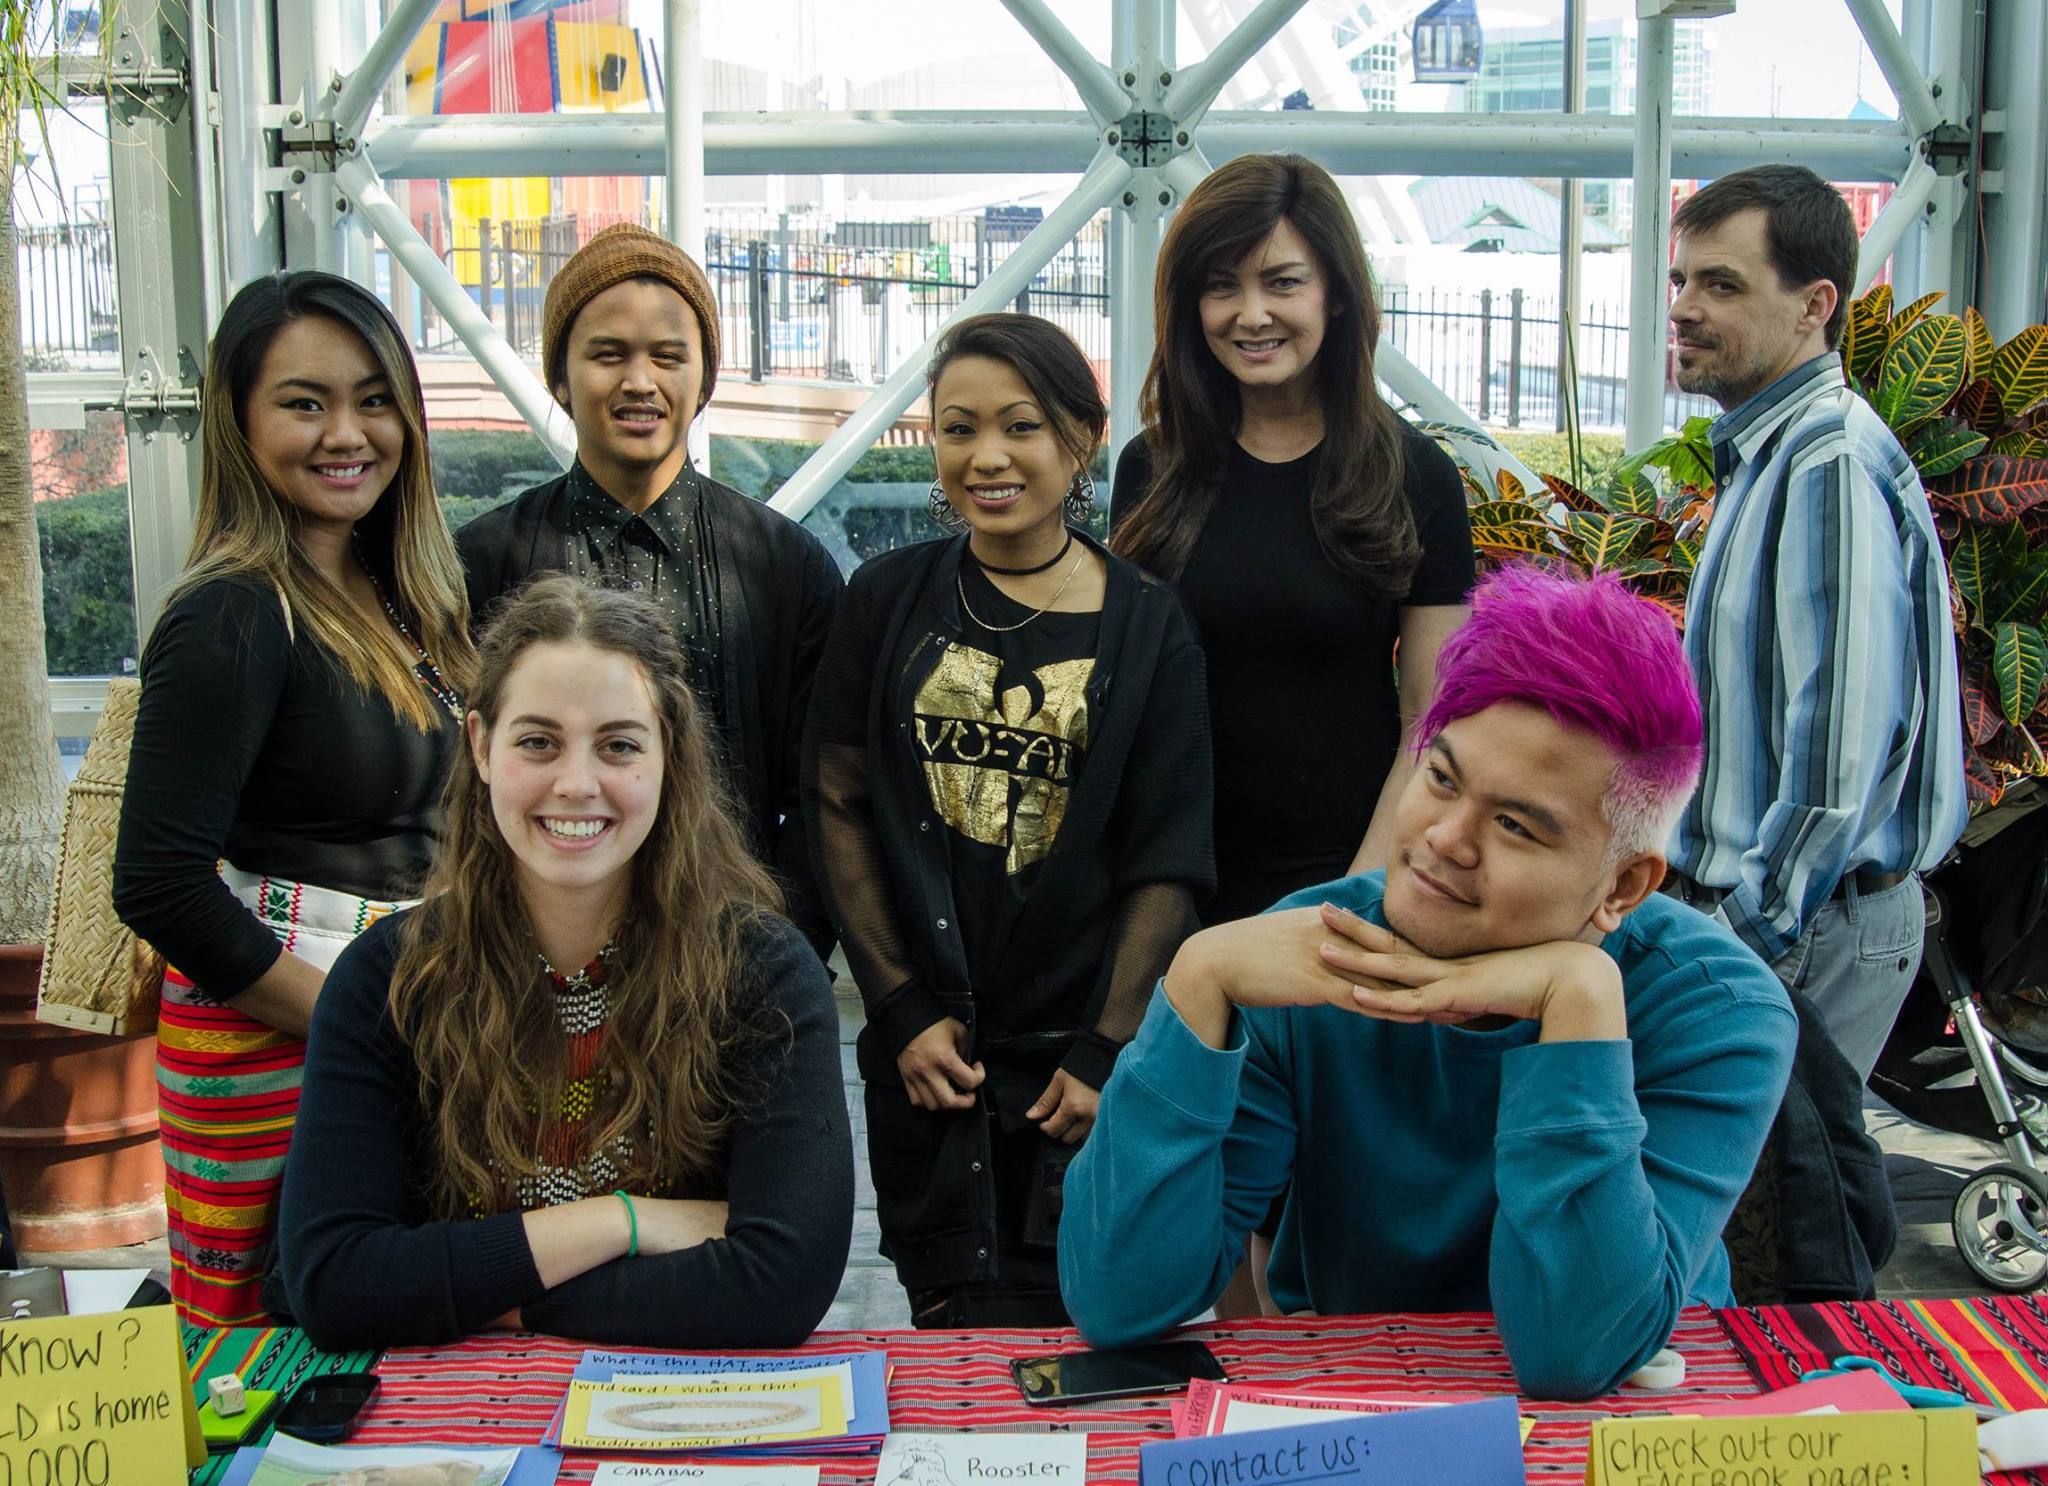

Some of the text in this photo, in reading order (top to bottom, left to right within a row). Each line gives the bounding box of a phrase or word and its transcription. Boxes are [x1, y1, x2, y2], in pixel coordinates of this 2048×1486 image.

[592, 1355, 637, 1366] What
[644, 1357, 656, 1366] is
[663, 1356, 697, 1367] this
[708, 1358, 750, 1369] HAT
[57, 1396, 81, 1433] is
[94, 1390, 171, 1430] home
[1719, 1425, 1780, 1462] out
[1787, 1431, 1844, 1462] our
[612, 1466, 705, 1478] CARABAO
[967, 1457, 1071, 1479] Rooster
